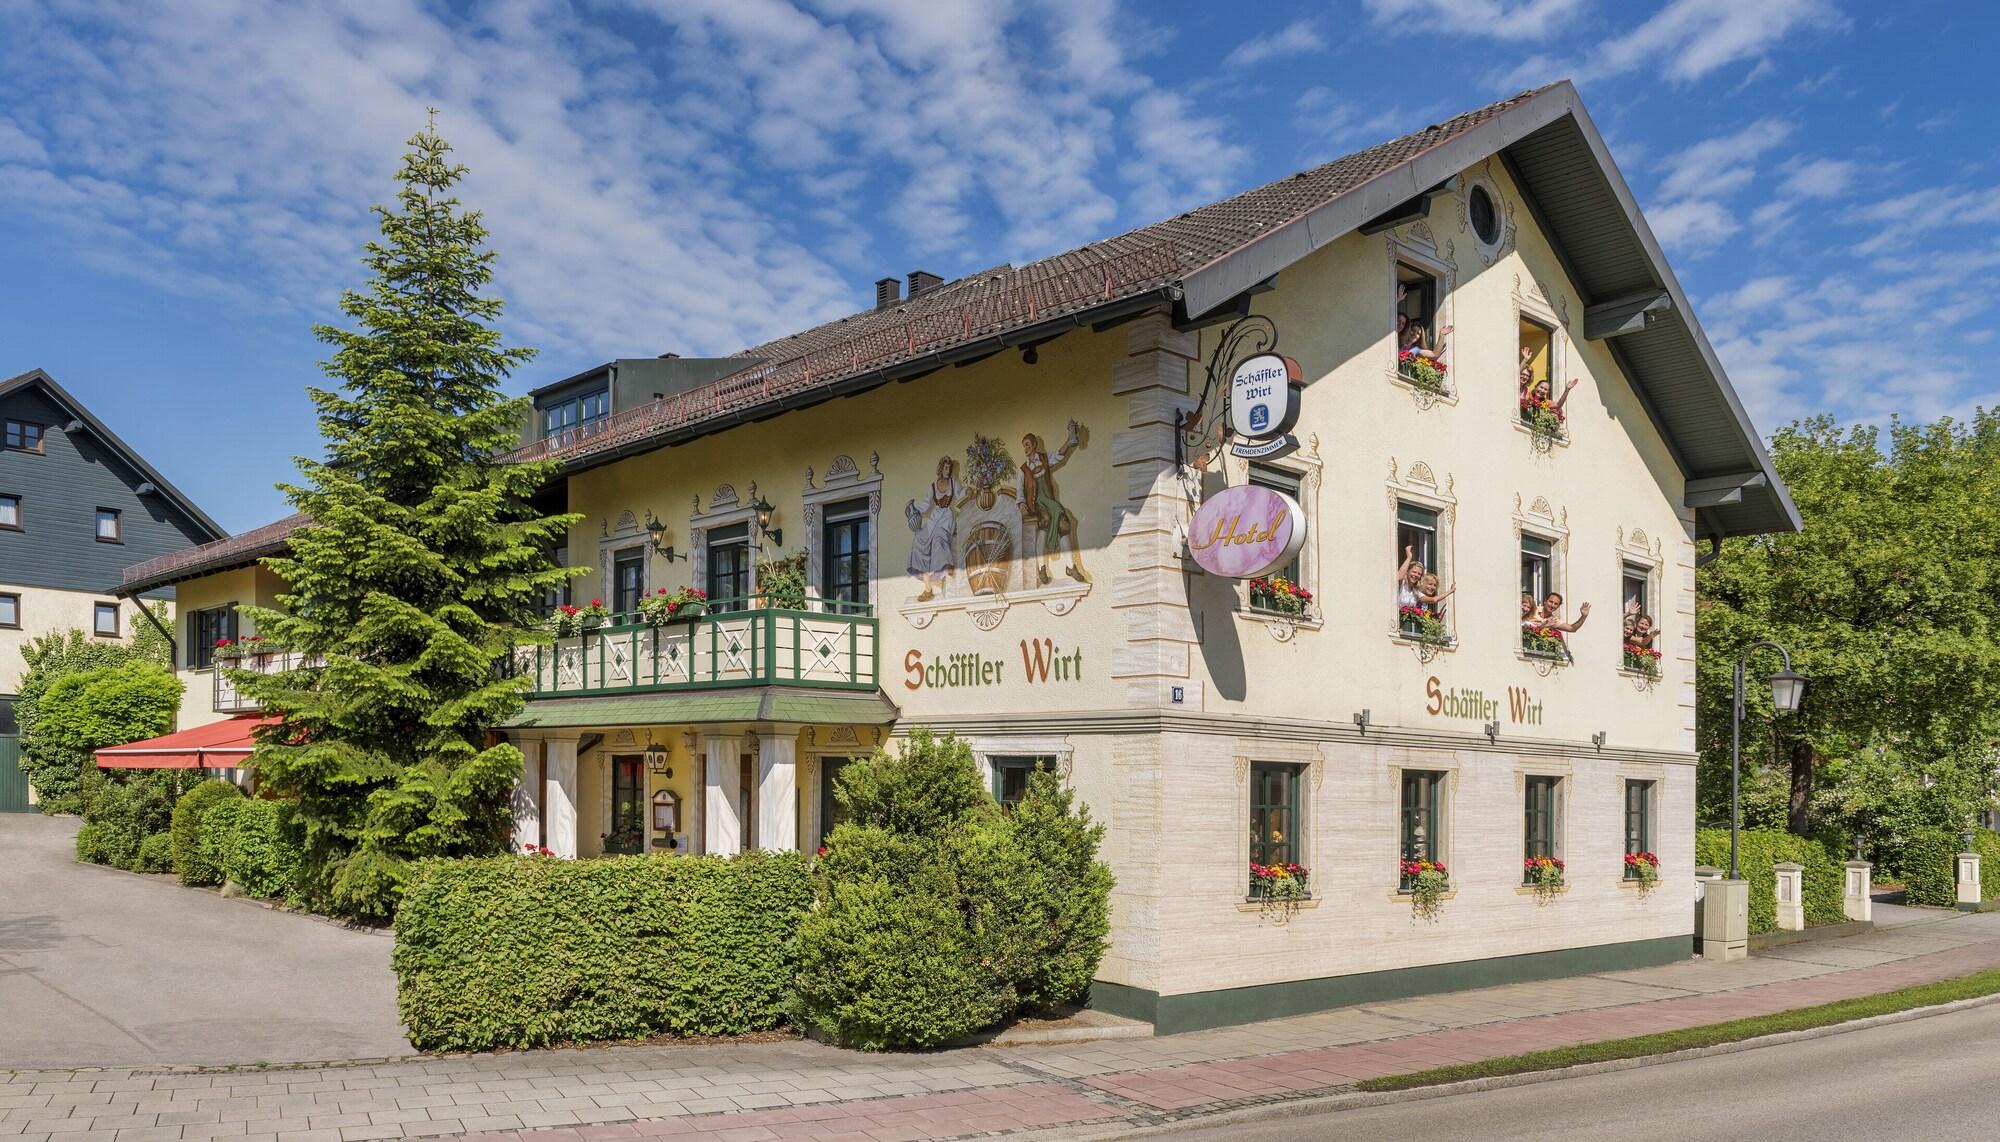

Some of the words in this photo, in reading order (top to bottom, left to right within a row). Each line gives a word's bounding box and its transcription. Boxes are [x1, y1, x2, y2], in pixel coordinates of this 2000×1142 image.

[1235, 368, 1283, 387] Schäffler
[1246, 386, 1272, 400] Wirt
[1235, 440, 1283, 455] FREMDENZIMMER
[1191, 509, 1286, 549] Hotel
[904, 649, 1004, 690] Schäffler
[1020, 638, 1082, 683] Wirt
[1426, 676, 1498, 720] Schäffler
[1508, 685, 1543, 726] Wirt
